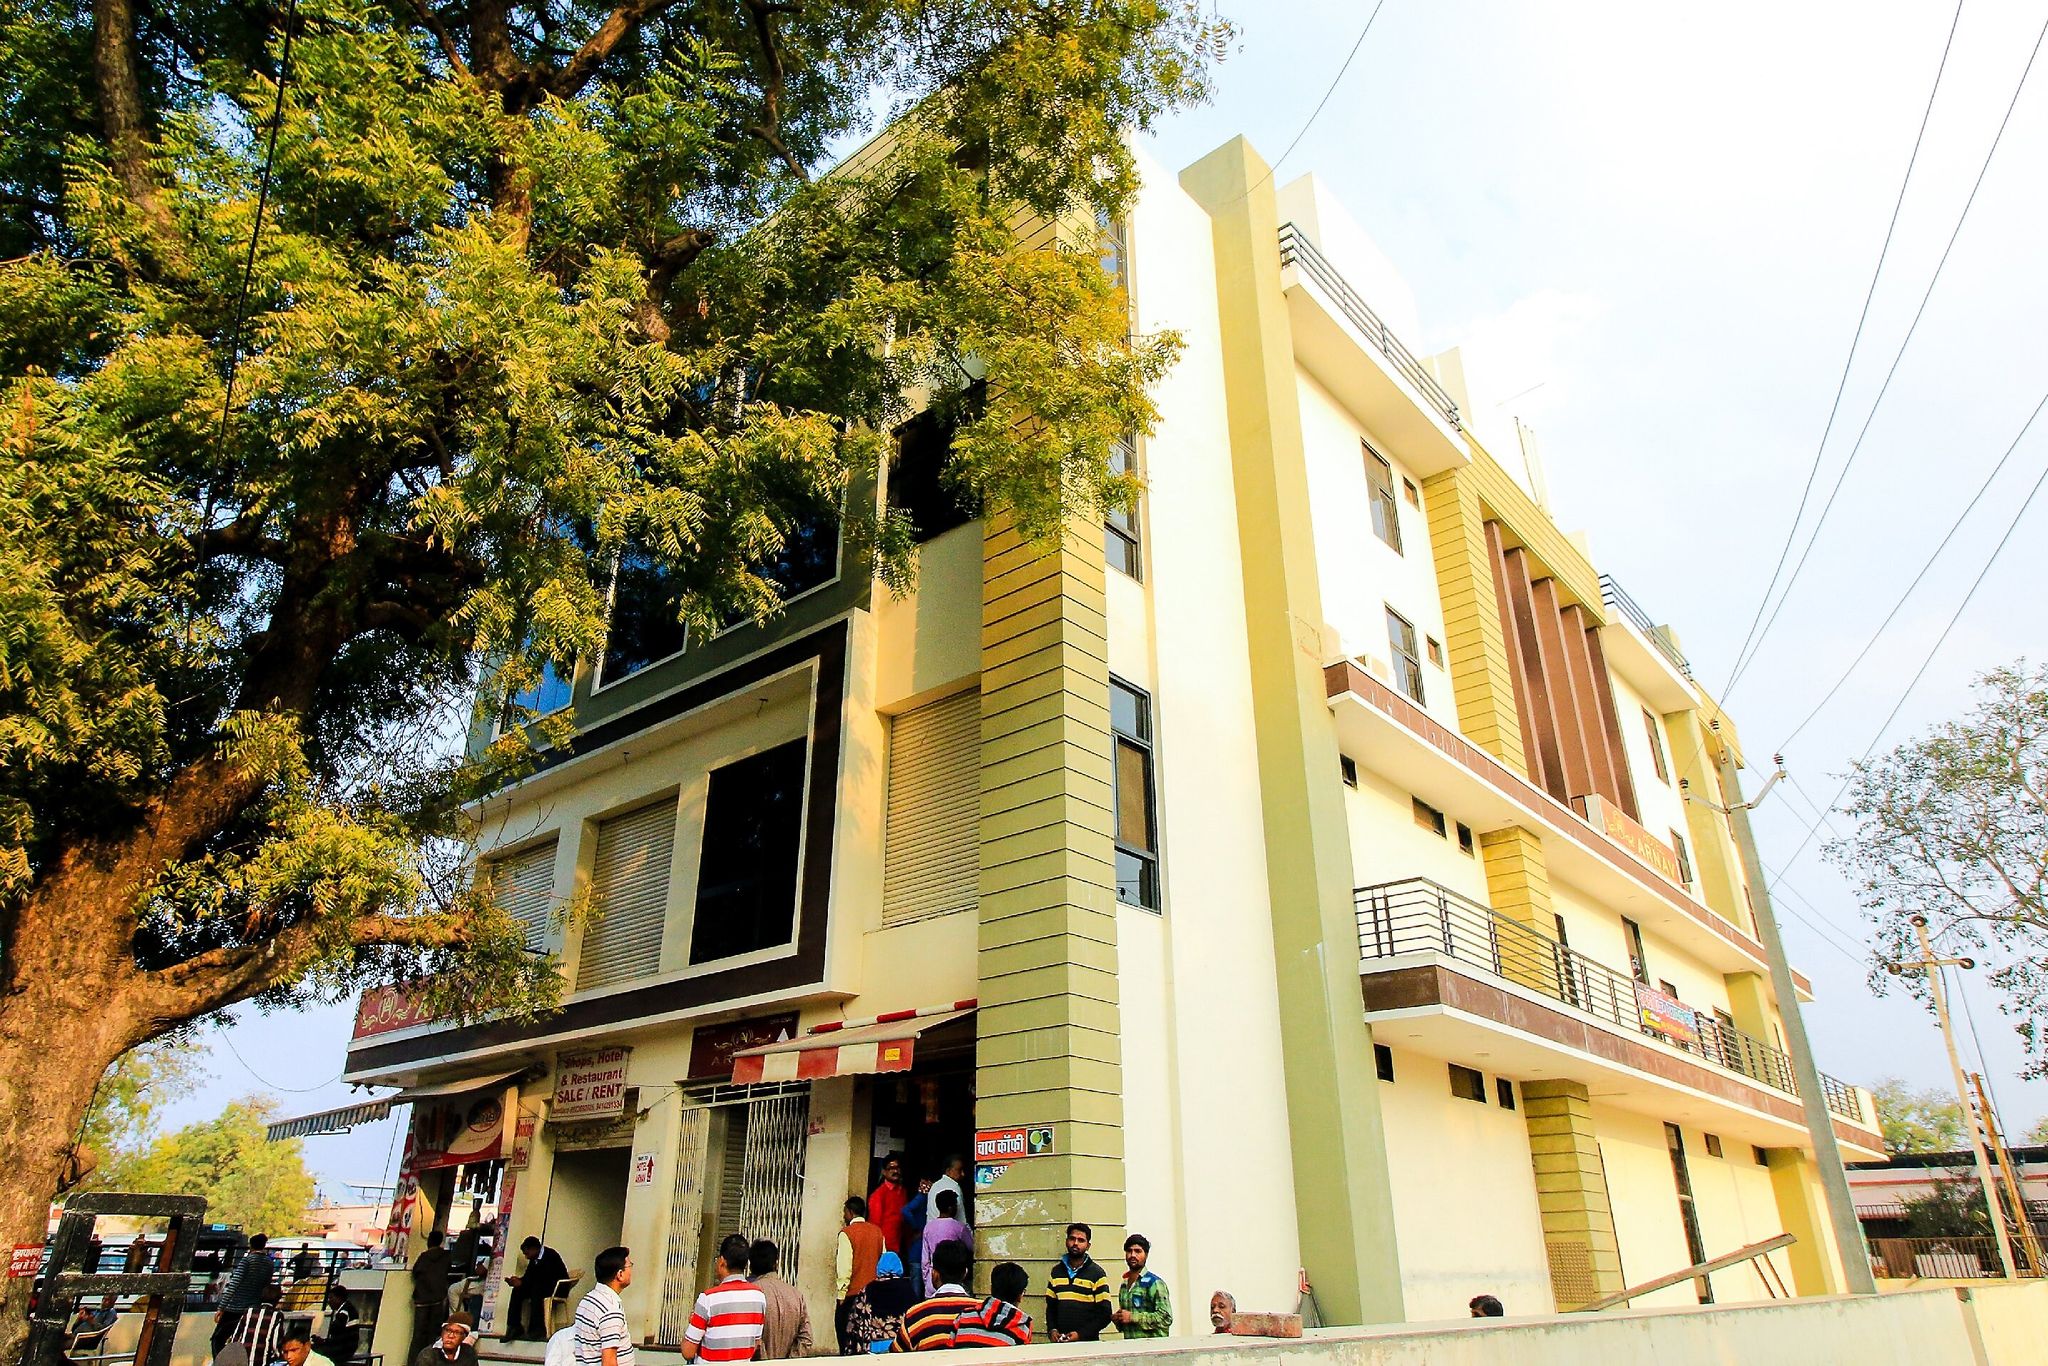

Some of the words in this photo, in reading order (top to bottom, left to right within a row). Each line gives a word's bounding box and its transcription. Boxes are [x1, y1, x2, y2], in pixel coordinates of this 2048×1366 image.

[597, 1050, 624, 1064] Hotel
[560, 1074, 568, 1087] &
[571, 1069, 623, 1086] Restaurant
[557, 1088, 584, 1104] SALE
[592, 1084, 622, 1100] RENT
[977, 1140, 997, 1156] चाय
[997, 1133, 1025, 1154] कॉफी
